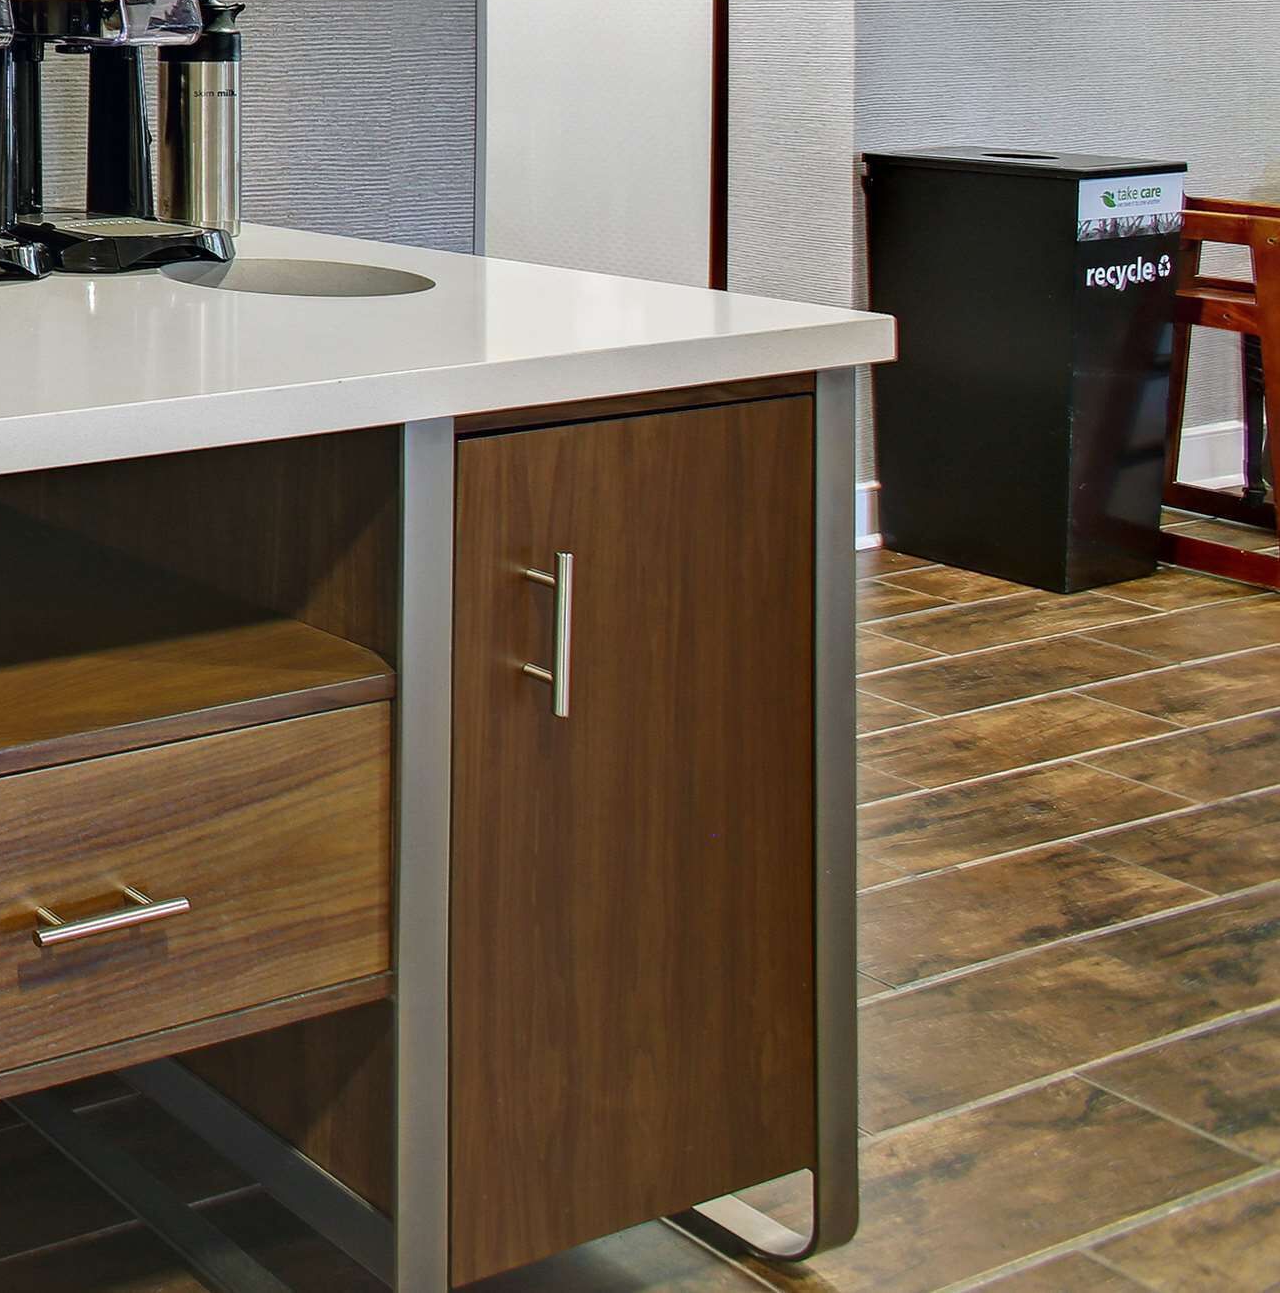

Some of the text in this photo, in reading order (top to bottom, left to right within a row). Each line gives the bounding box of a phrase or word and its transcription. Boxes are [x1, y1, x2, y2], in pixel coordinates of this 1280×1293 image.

[1117, 186, 1161, 201] take care
[1086, 256, 1156, 291] recycle
